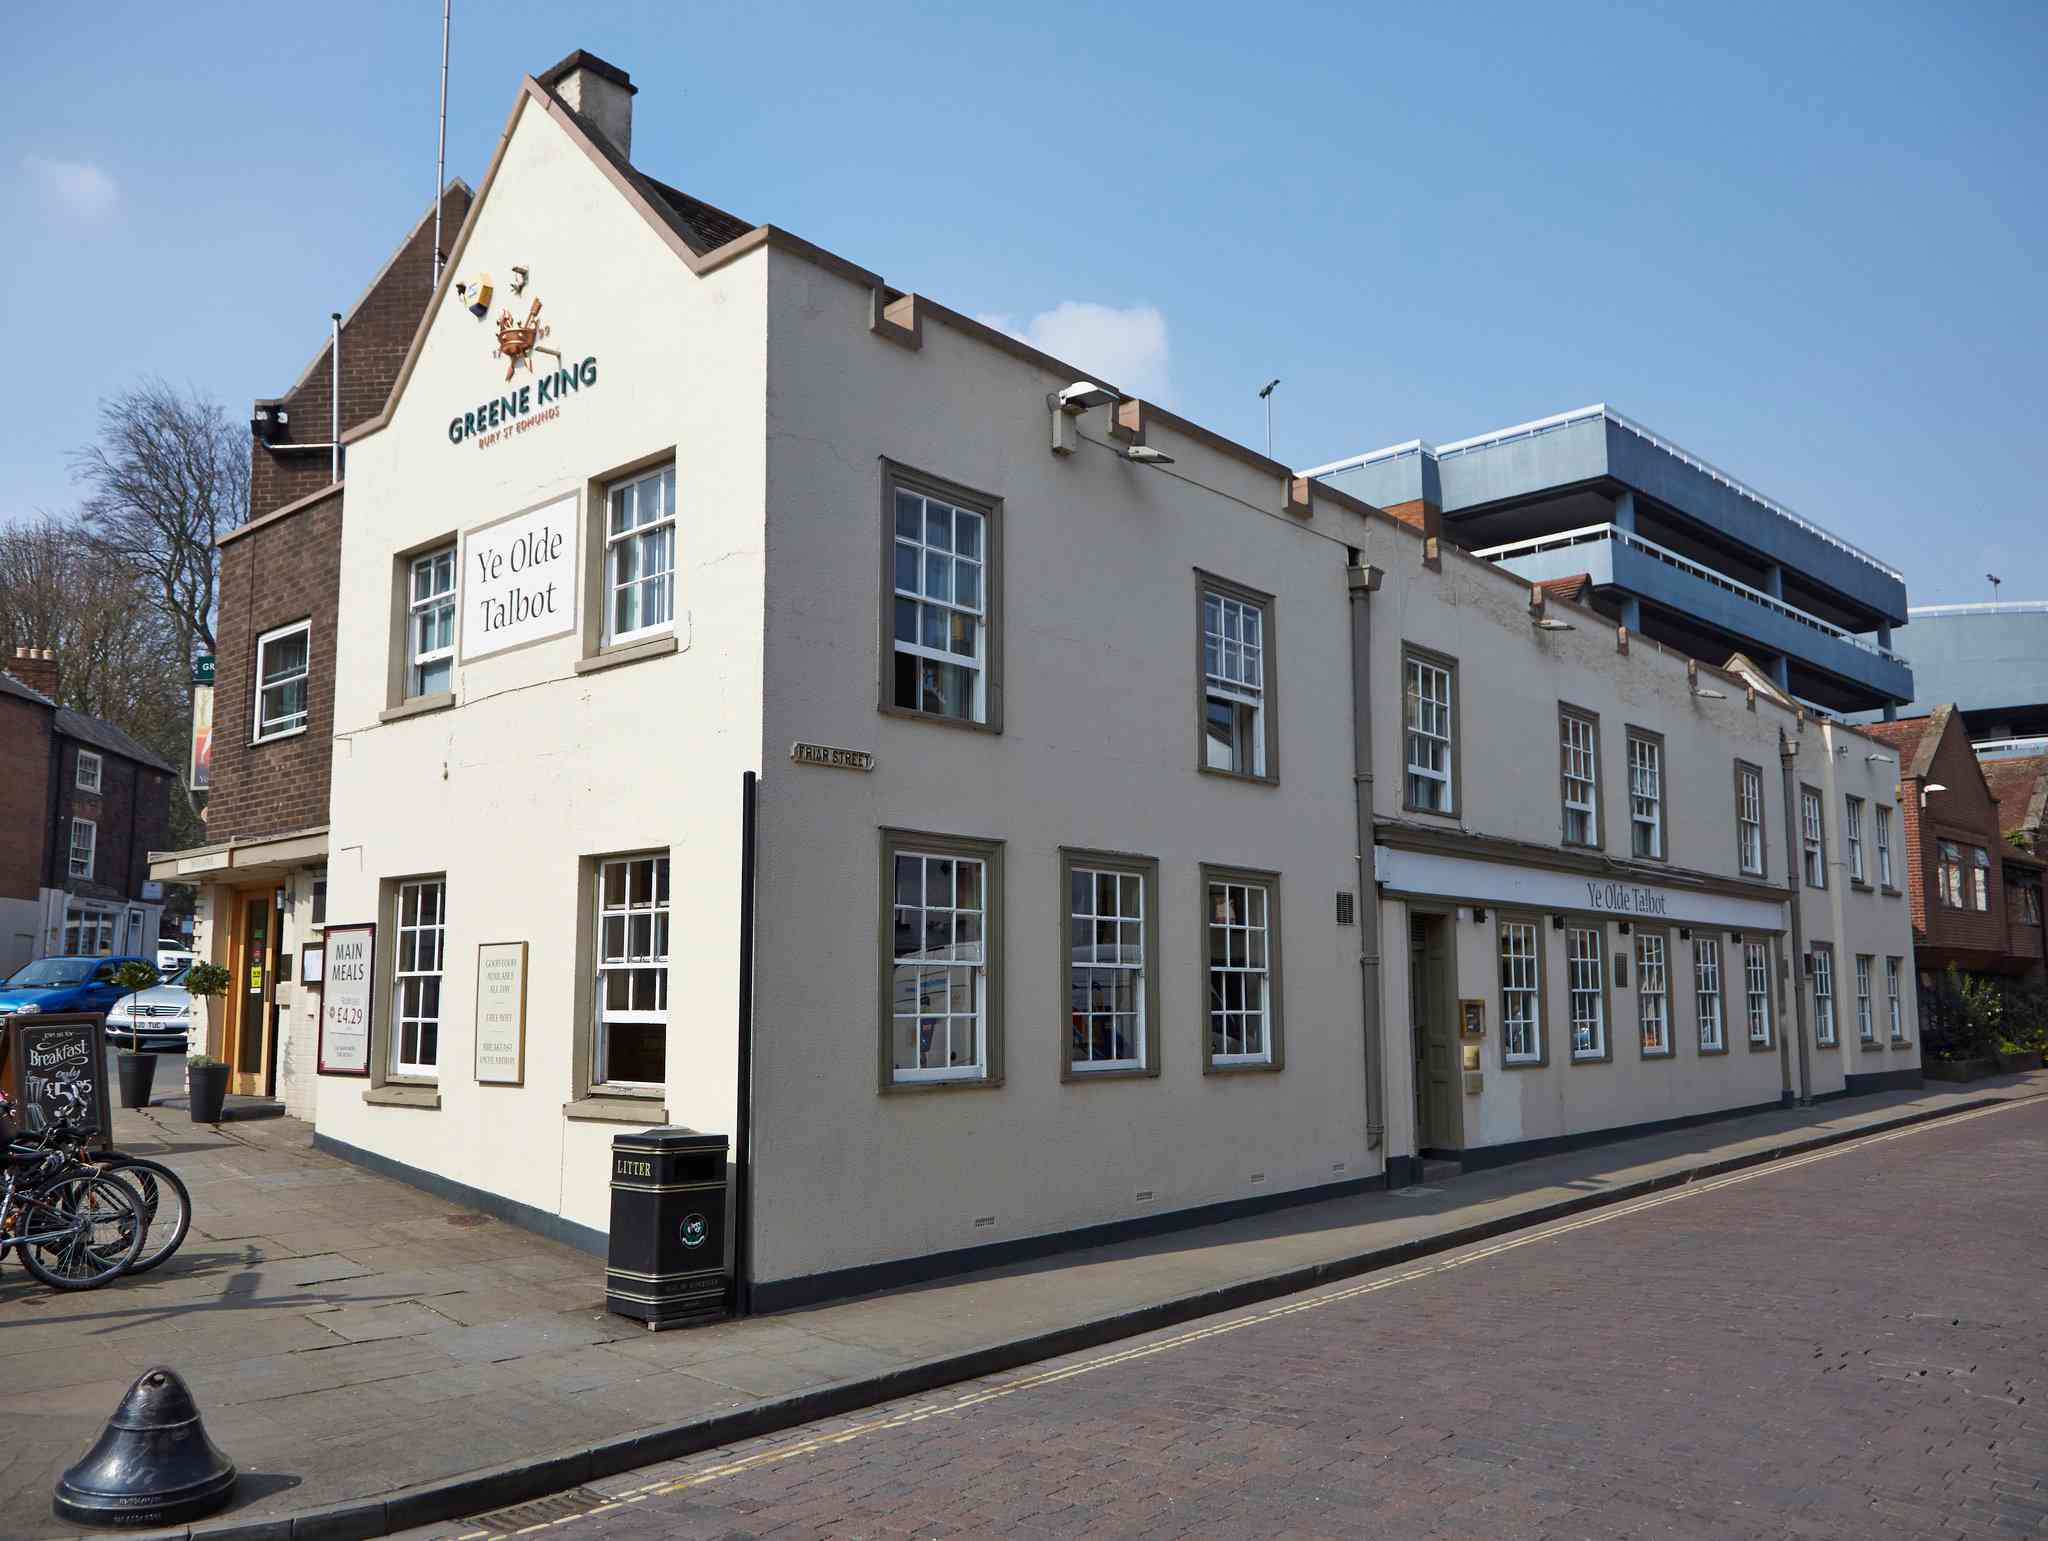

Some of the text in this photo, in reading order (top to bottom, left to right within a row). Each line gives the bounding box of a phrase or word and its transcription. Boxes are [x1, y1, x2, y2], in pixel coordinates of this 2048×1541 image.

[448, 356, 598, 444] GREENE KING
[479, 405, 560, 449] BURY ST EDMUNDS
[478, 526, 562, 583] Ye Olde
[480, 582, 558, 632] Talbot
[832, 749, 870, 768] STREET
[1587, 882, 1667, 915] Ye Olde Talbot
[336, 943, 363, 961] MAIN
[332, 963, 365, 981] MEALS
[337, 1007, 363, 1025] £4.29
[30, 1039, 88, 1067] Breakfast
[617, 1159, 651, 1176] LITTER
